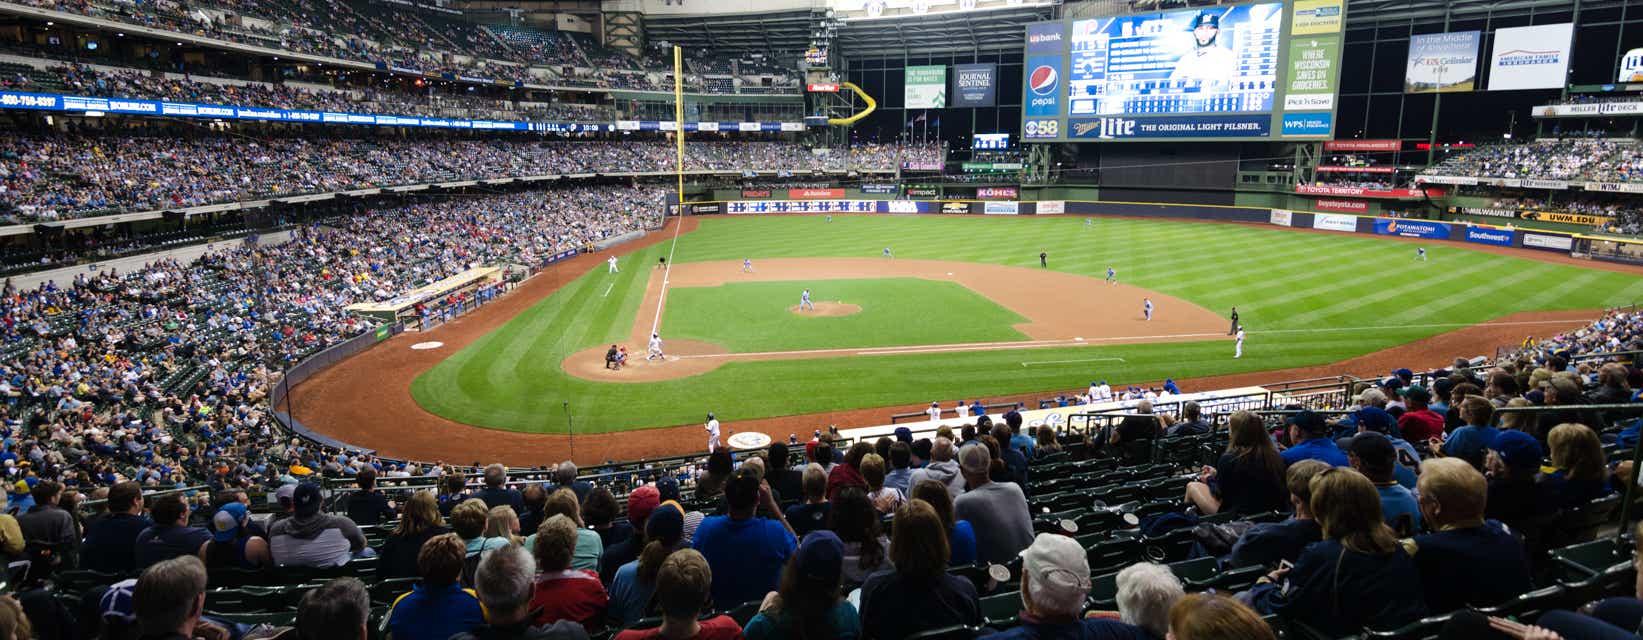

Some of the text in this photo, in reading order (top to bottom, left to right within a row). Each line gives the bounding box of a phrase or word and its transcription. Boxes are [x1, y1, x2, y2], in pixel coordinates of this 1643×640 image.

[1302, 49, 1326, 60] WHERE
[1294, 59, 1331, 70] WISCONSIN
[959, 72, 991, 80] JOURNAL
[1296, 69, 1327, 80] SAVES ON
[958, 79, 991, 87] SENTINEL
[1031, 97, 1055, 107] pepsi
[1618, 103, 1638, 111] DECK
[1037, 120, 1058, 135] 58
[1098, 116, 1136, 139] Lite
[1141, 124, 1157, 132] THE
[1158, 123, 1195, 132] ORIGINAL
[1197, 122, 1222, 131] LIGHT
[1223, 121, 1261, 131] PILSNER.
[1284, 120, 1304, 128] WPS
[1331, 187, 1364, 195] TERRITORY
[1549, 211, 1595, 224] UWM.EDU
[1469, 231, 1504, 242] Southwest
